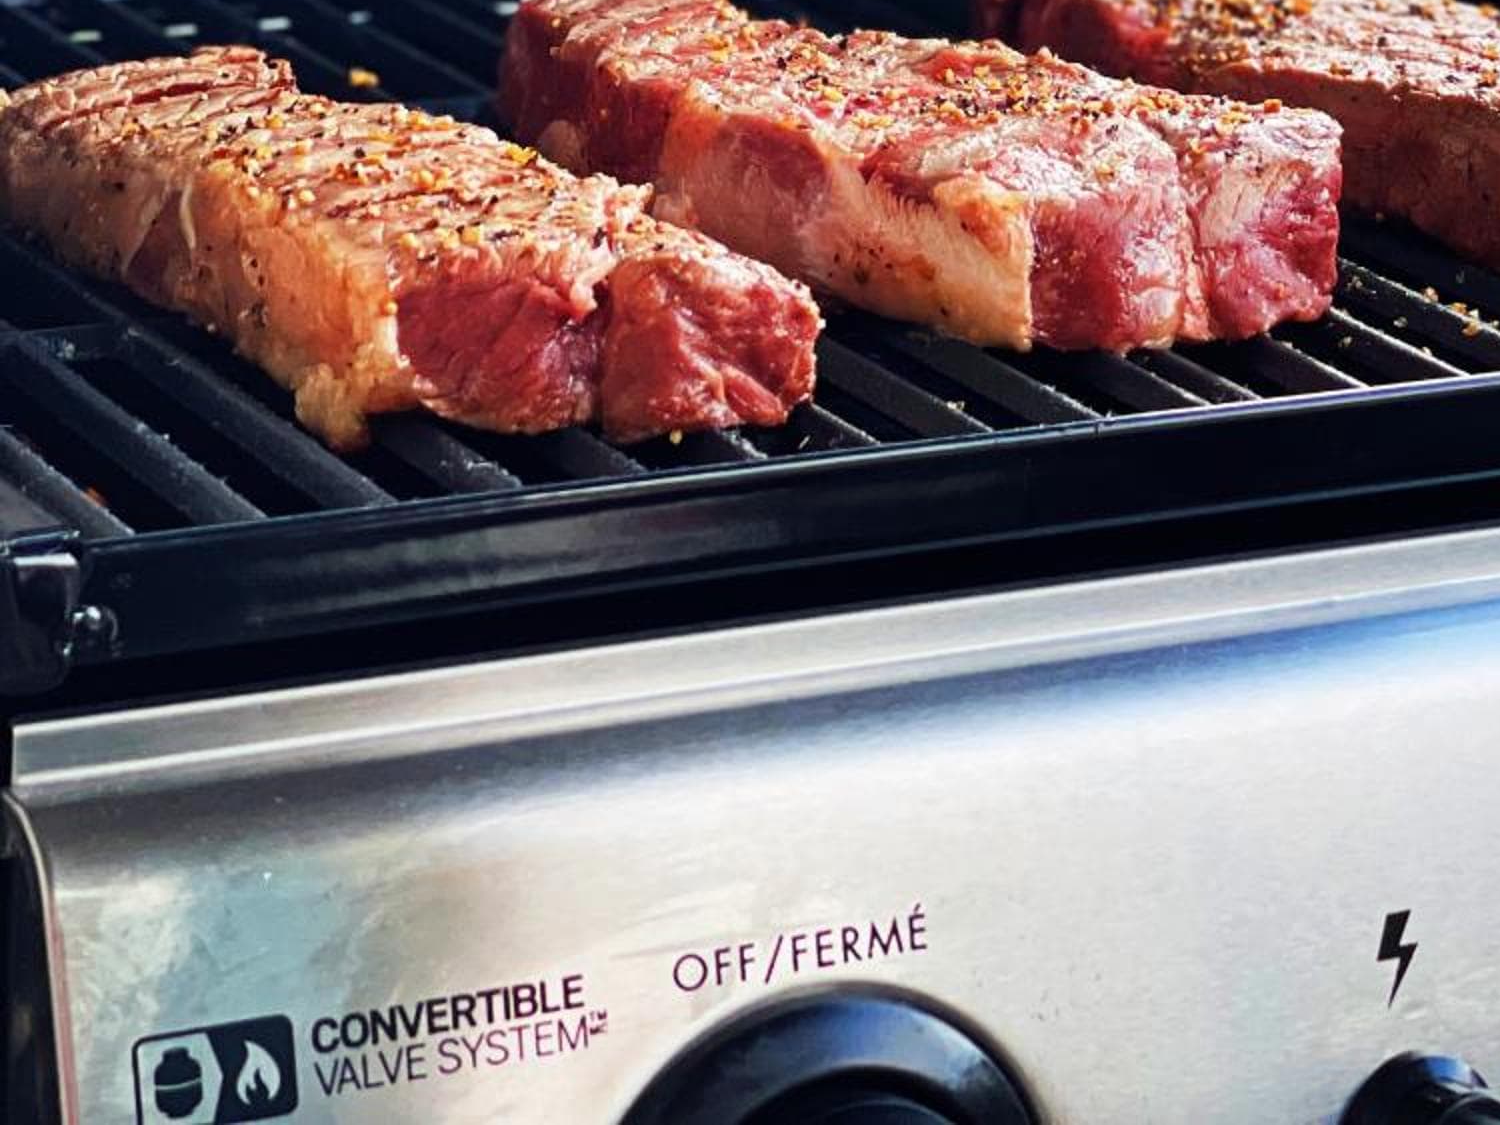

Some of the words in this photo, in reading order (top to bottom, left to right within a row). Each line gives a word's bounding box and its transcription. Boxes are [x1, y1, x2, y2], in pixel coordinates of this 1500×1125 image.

[672, 903, 928, 992] OFF/FERMÉ
[311, 974, 586, 1055] CONVERTIBLE
[314, 1043, 428, 1097] VALVE
